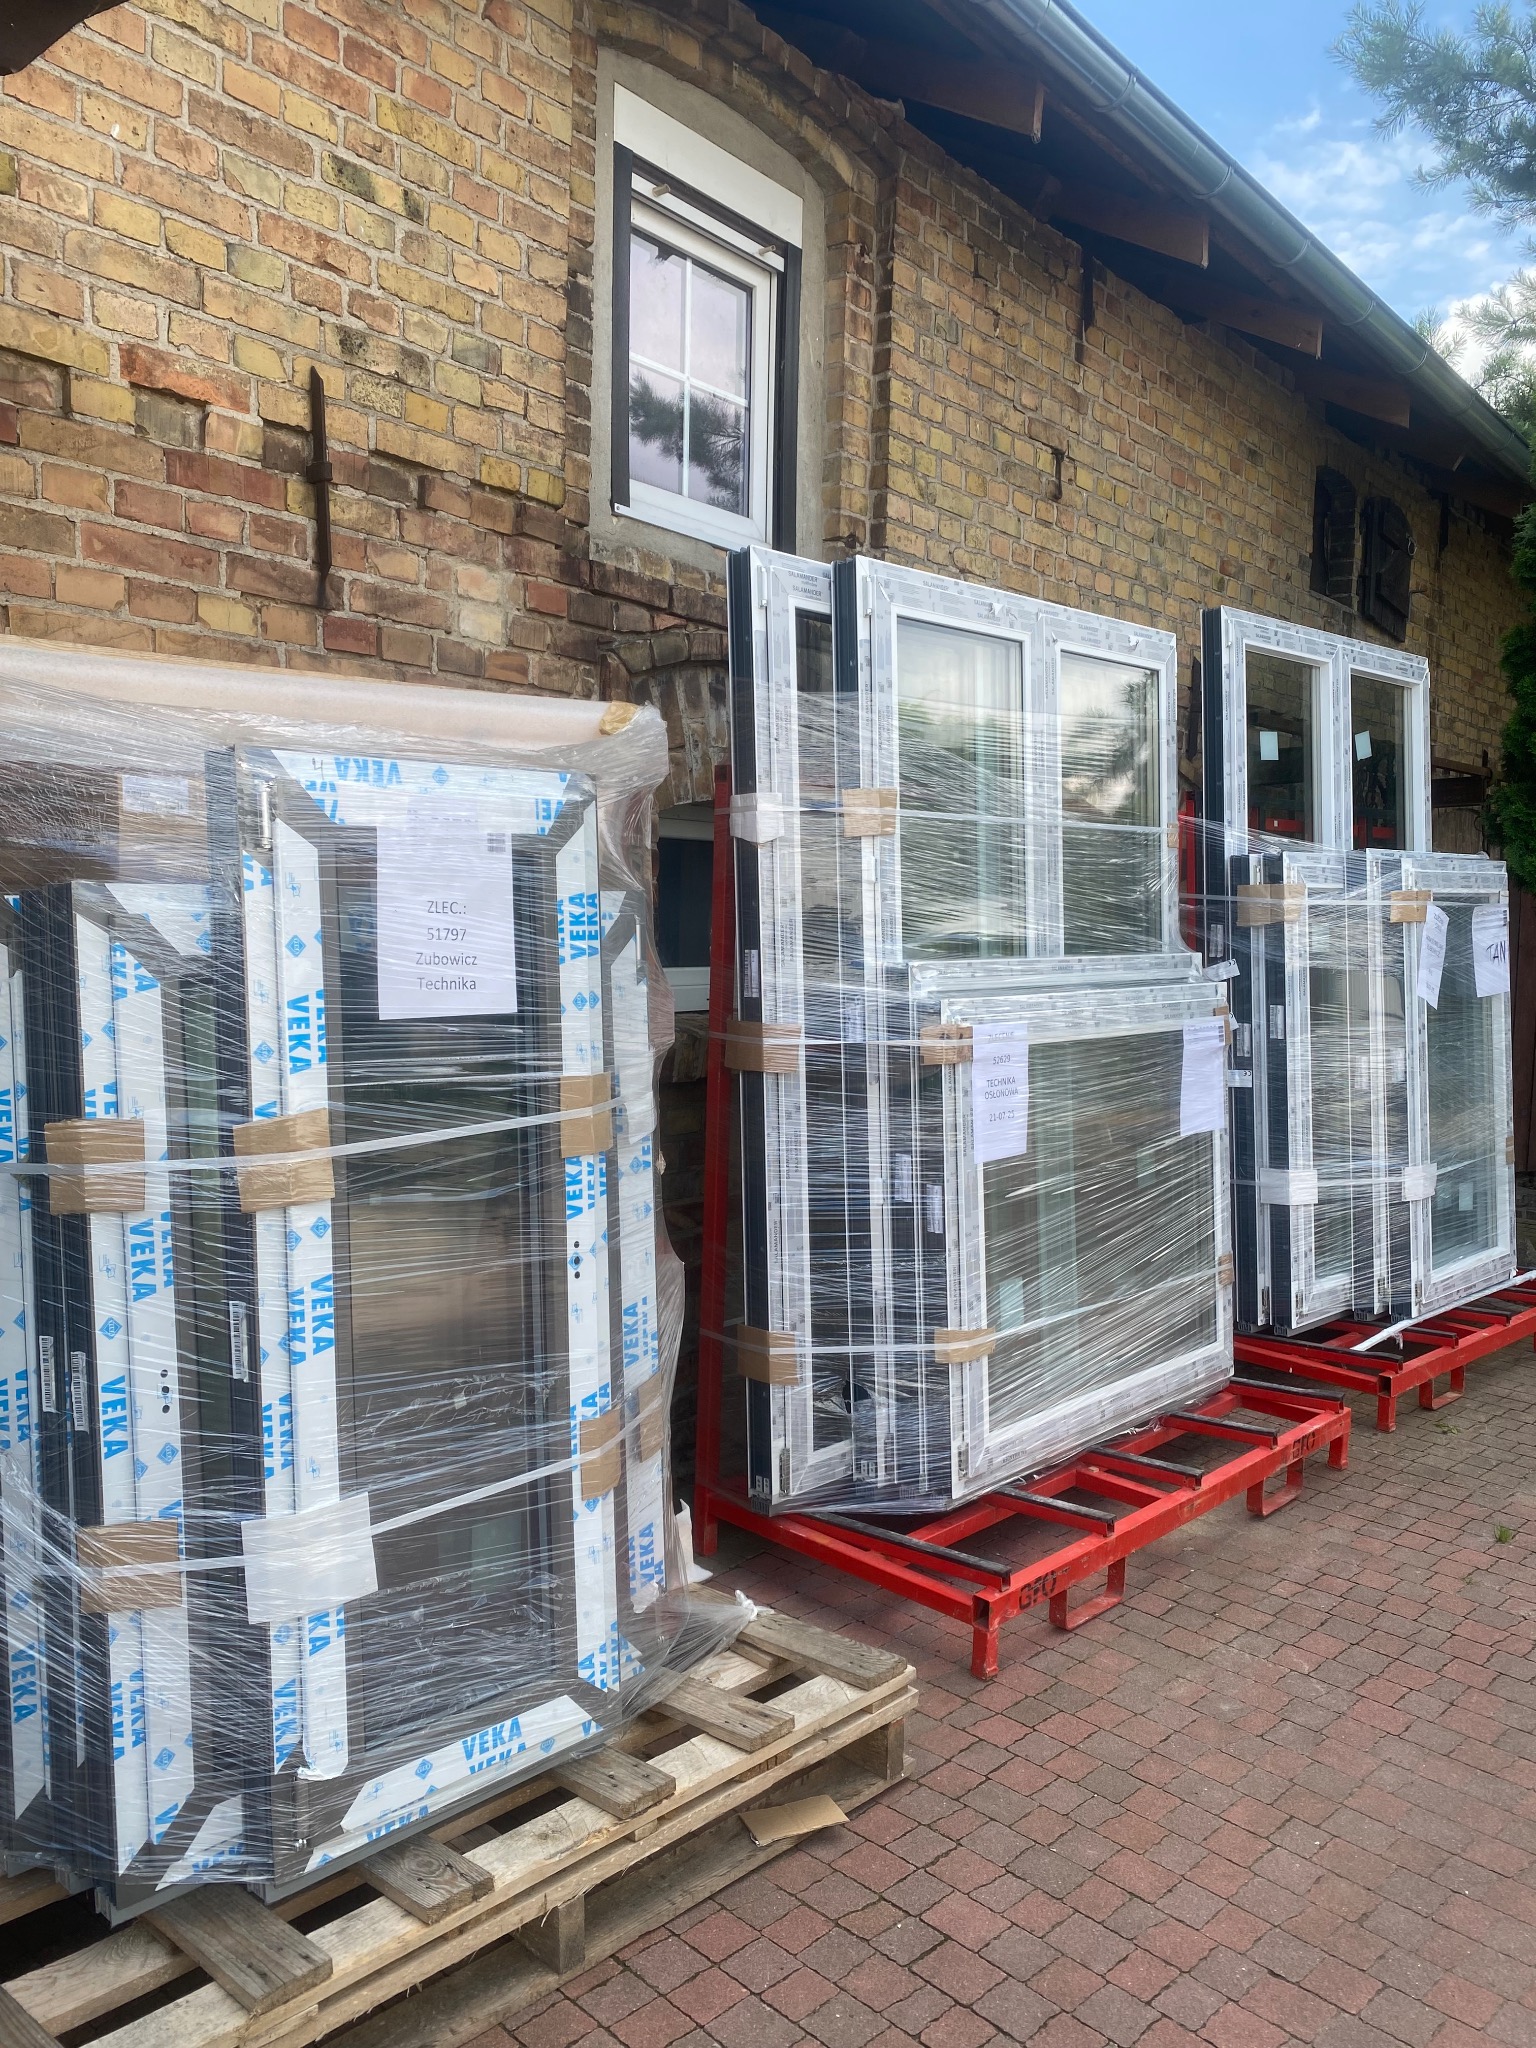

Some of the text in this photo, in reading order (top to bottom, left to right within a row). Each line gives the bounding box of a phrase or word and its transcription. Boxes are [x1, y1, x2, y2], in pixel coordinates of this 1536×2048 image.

[333, 756, 402, 785] VEKA
[427, 900, 467, 915] ZLEC.:
[569, 892, 587, 960] VEKA
[427, 927, 467, 942] 51797
[415, 951, 478, 967] Zubowicz
[417, 976, 477, 991] Technika
[287, 994, 312, 1075] VEKA
[993, 1054, 1011, 1065] 52629
[984, 1088, 1019, 1100] OSŁONOWA
[986, 1076, 1016, 1089] TECHNIKA
[129, 1218, 157, 1302] VEKA
[311, 1273, 334, 1356] VEKA
[623, 1302, 639, 1368] VEKA
[101, 1375, 129, 1460] VEKA
[11, 1643, 38, 1724] VEKA
[274, 1678, 298, 1765] VEKA
[461, 1717, 522, 1761] VEKA
